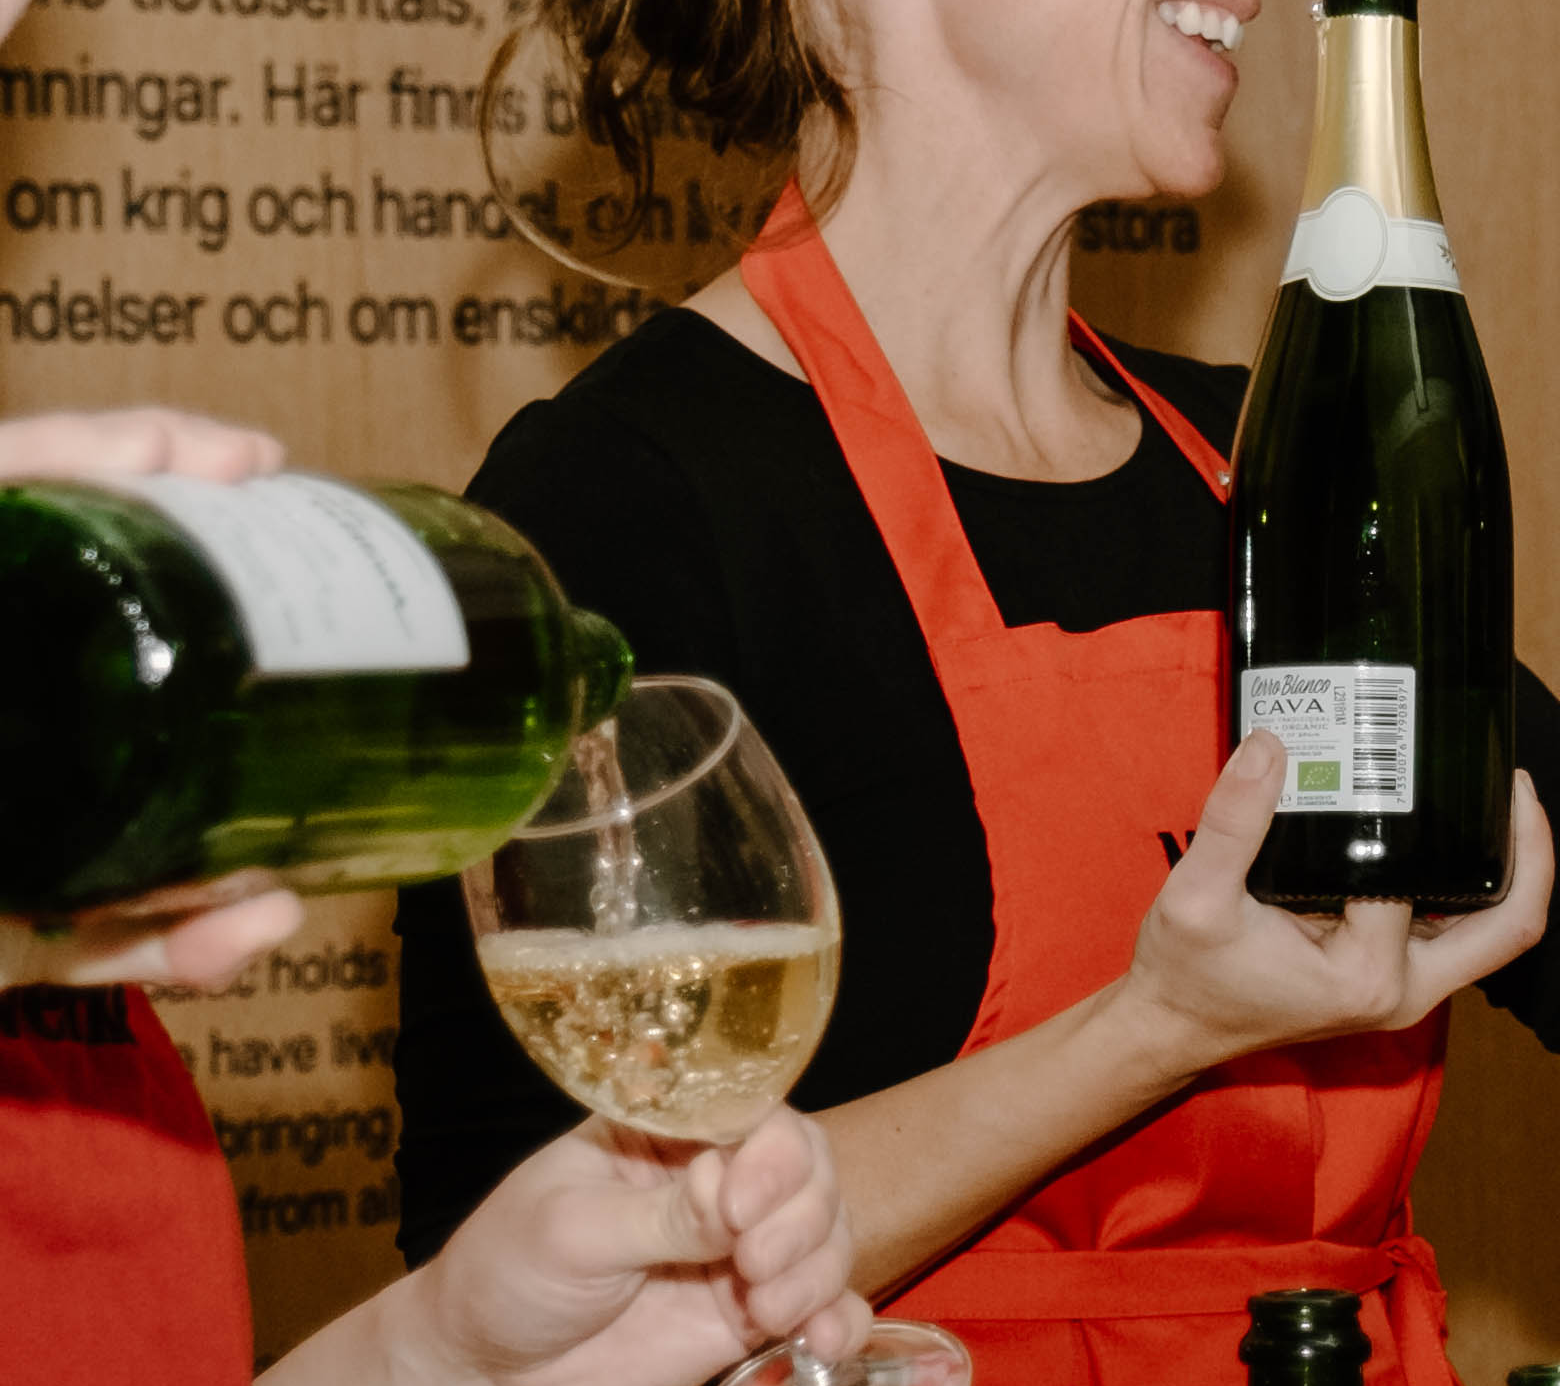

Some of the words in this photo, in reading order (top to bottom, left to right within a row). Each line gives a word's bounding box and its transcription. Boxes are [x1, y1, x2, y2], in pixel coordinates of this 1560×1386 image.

[262, 60, 366, 129] Här
[387, 65, 528, 136] finns
[5, 175, 104, 232] om
[122, 164, 230, 253] krig
[247, 169, 356, 236] och
[1075, 198, 1202, 255] stora
[222, 277, 333, 346] och
[346, 293, 439, 346] om
[1250, 676, 1281, 697] Cerro
[1281, 673, 1332, 695] Blanco
[1253, 697, 1326, 717] CAVA
[1397, 687, 1410, 734] 790897
[1396, 743, 1408, 790] 350076
[268, 942, 389, 996] holds
[208, 1026, 318, 1078] have
[212, 1103, 394, 1167] bringing
[241, 1183, 349, 1235] from
